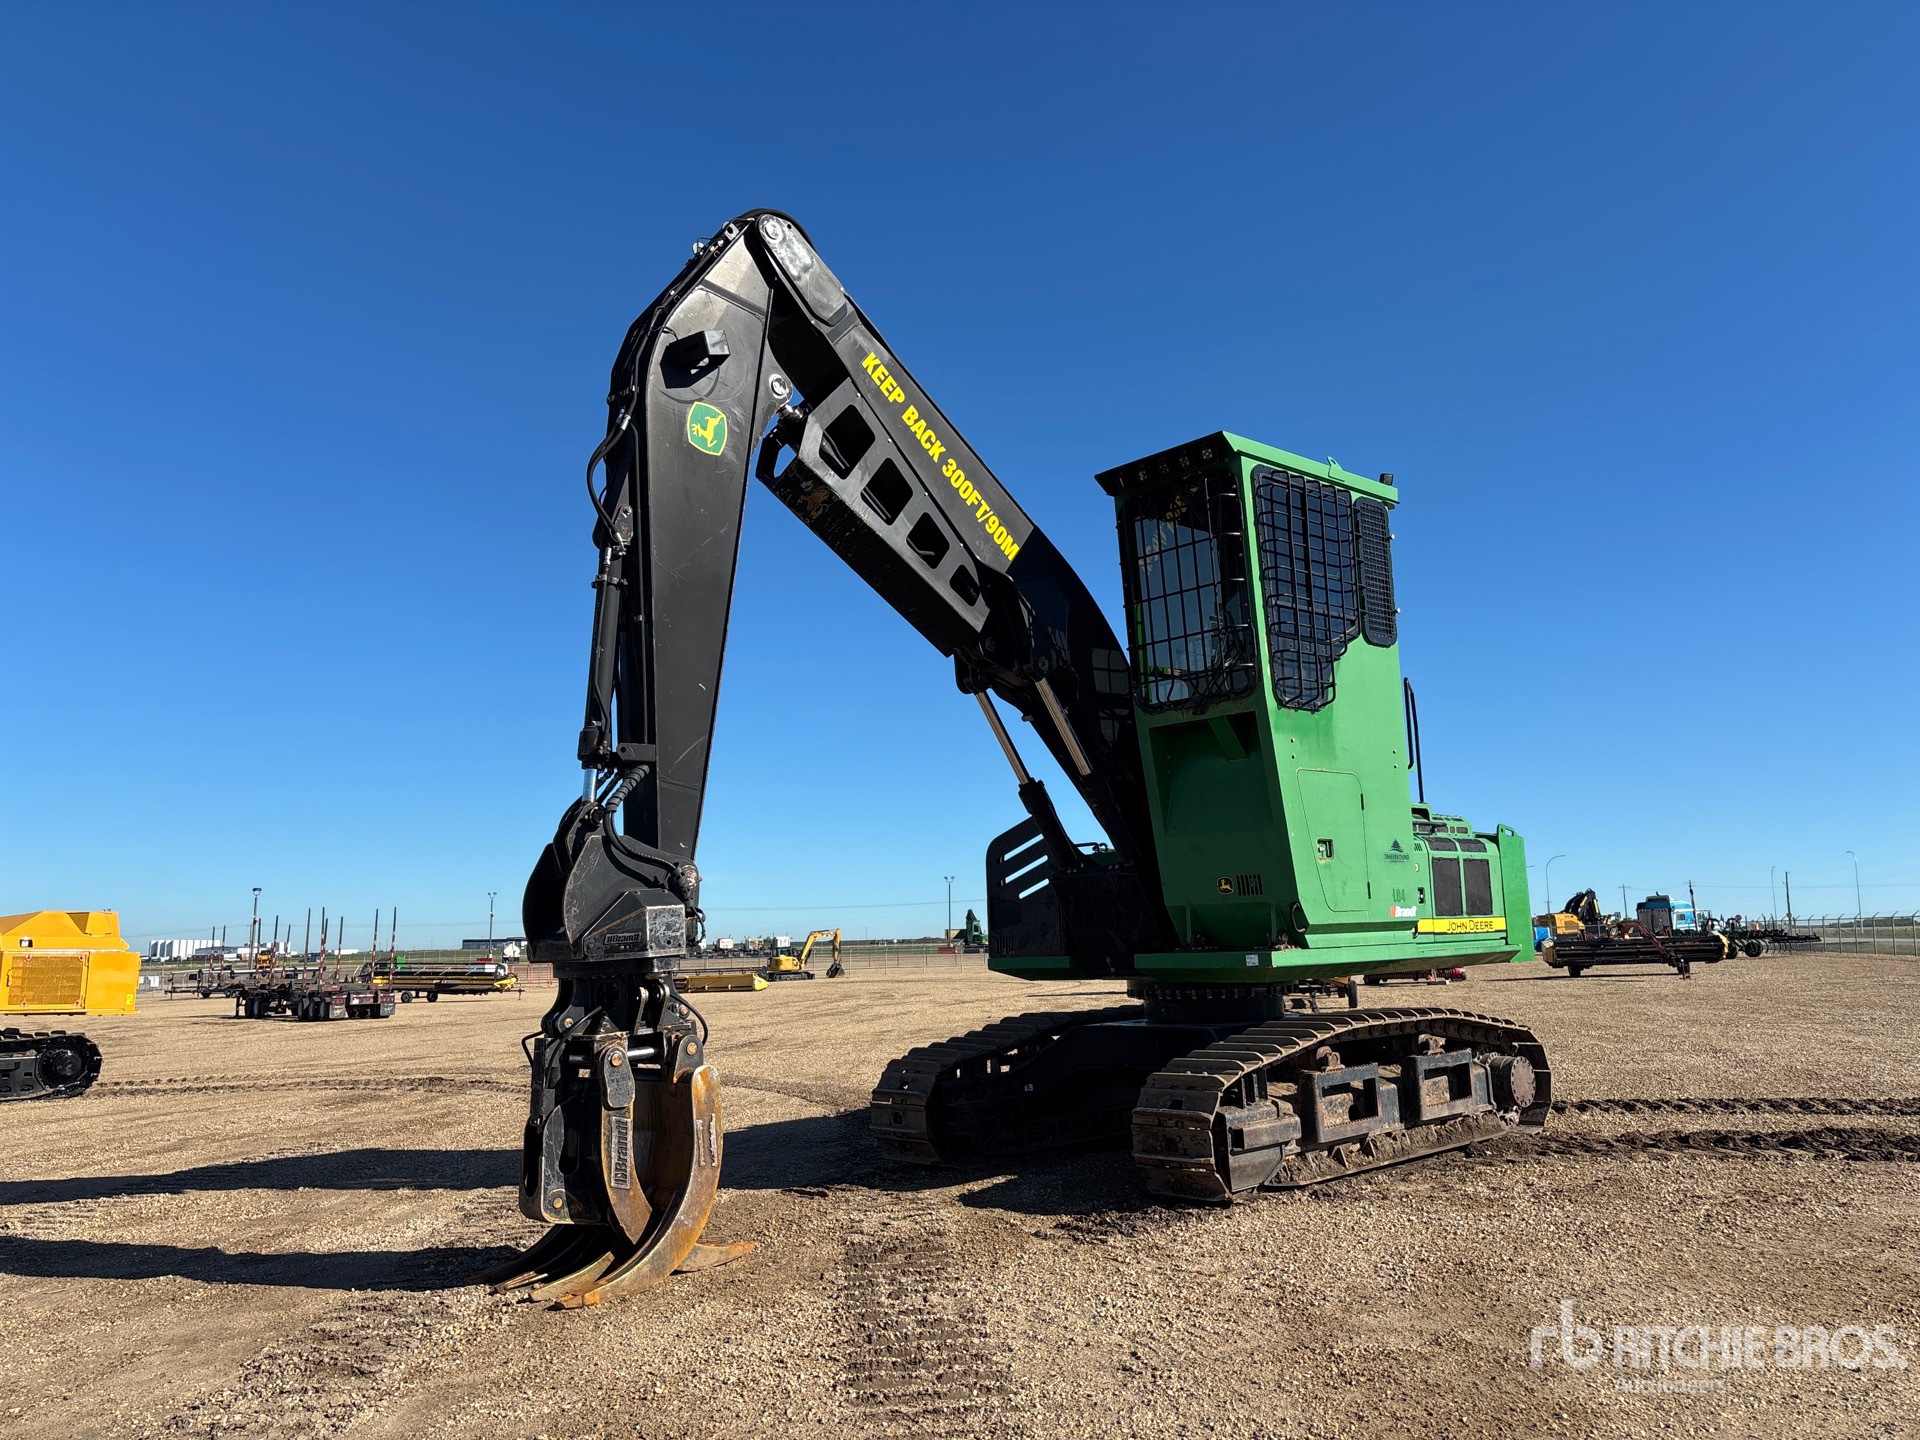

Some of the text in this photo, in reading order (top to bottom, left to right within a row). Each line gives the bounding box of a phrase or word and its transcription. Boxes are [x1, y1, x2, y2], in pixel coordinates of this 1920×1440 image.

[861, 351, 1020, 561] KEEP BACK 300FT/90M
[1446, 919, 1495, 932] JOHN DEERE
